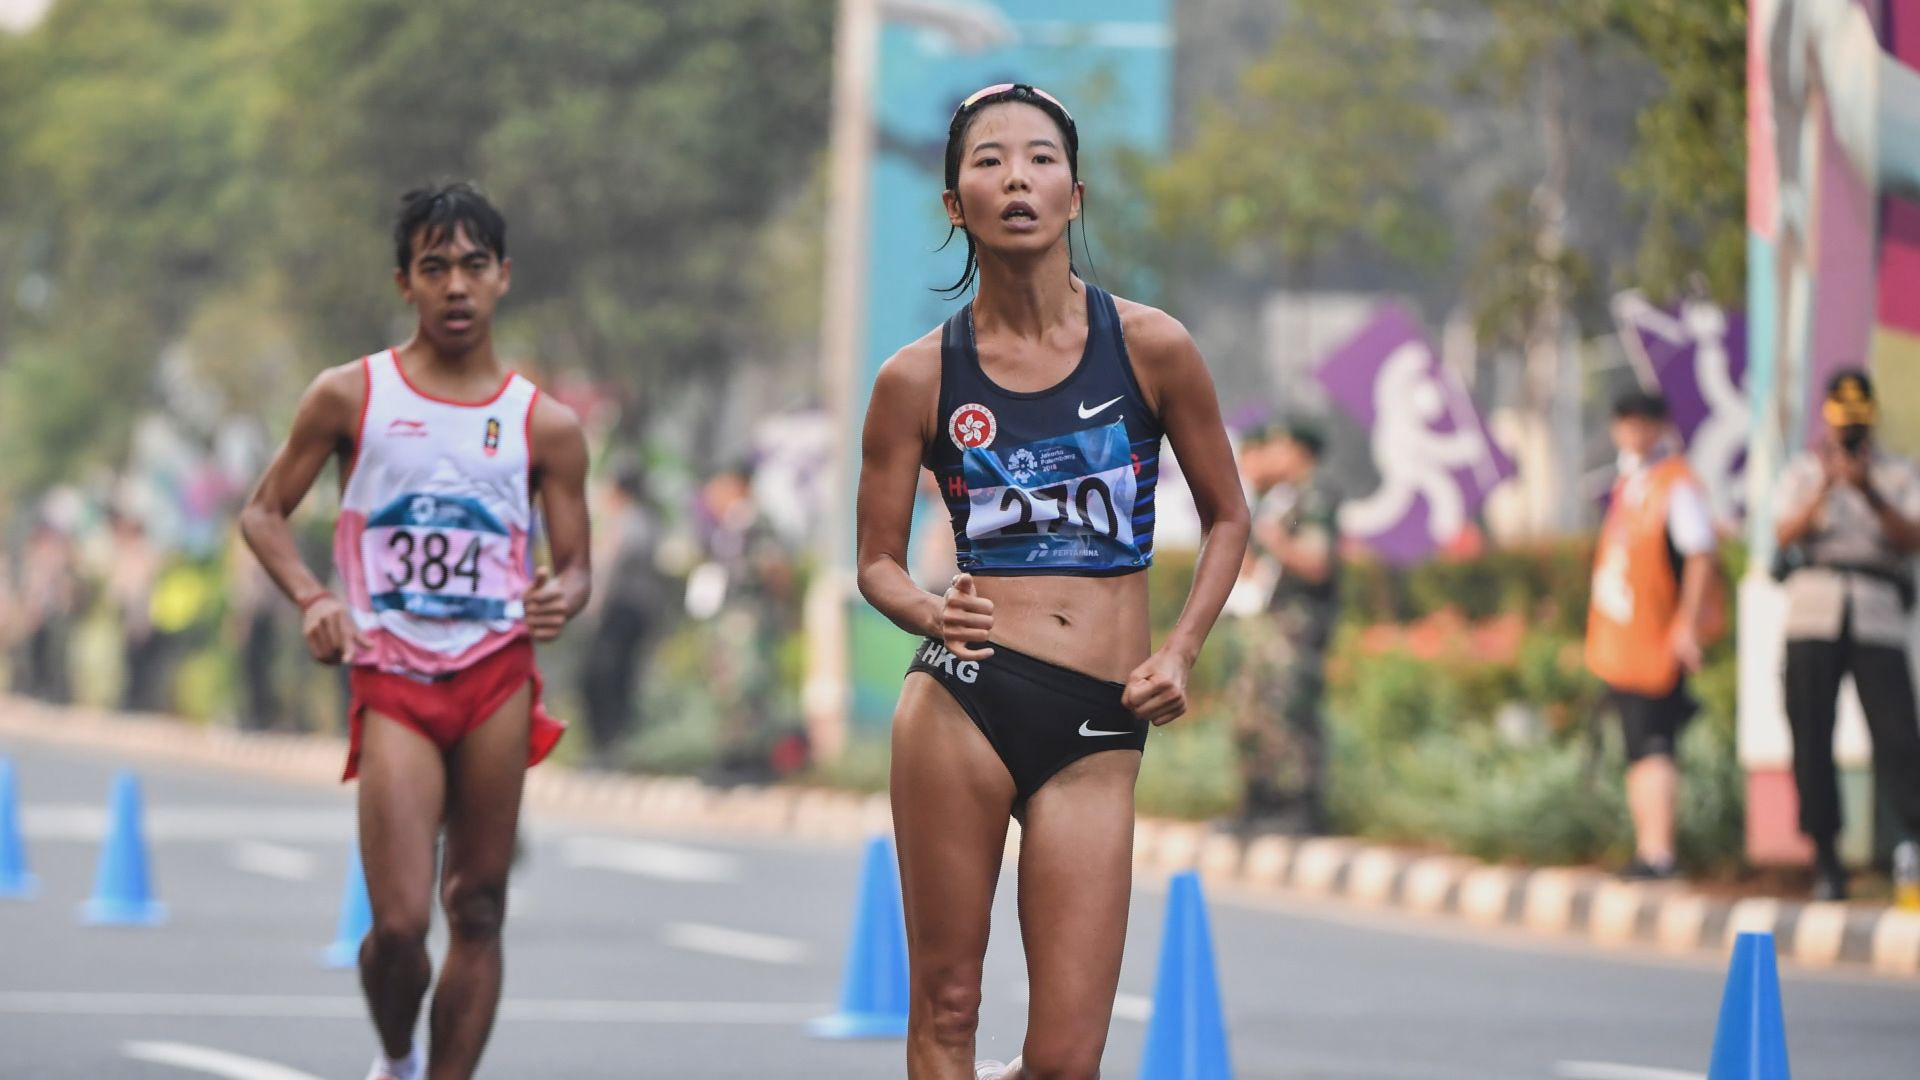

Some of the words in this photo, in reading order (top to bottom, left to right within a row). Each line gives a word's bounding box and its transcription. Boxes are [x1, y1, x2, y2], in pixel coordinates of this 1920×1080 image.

[1040, 450, 1064, 460] Jakarta
[1042, 463, 1058, 473] 2018
[1000, 477, 1118, 538] 270
[387, 530, 481, 592] 384
[1052, 548, 1100, 557] PERTAMINA
[921, 641, 980, 684] HKG
